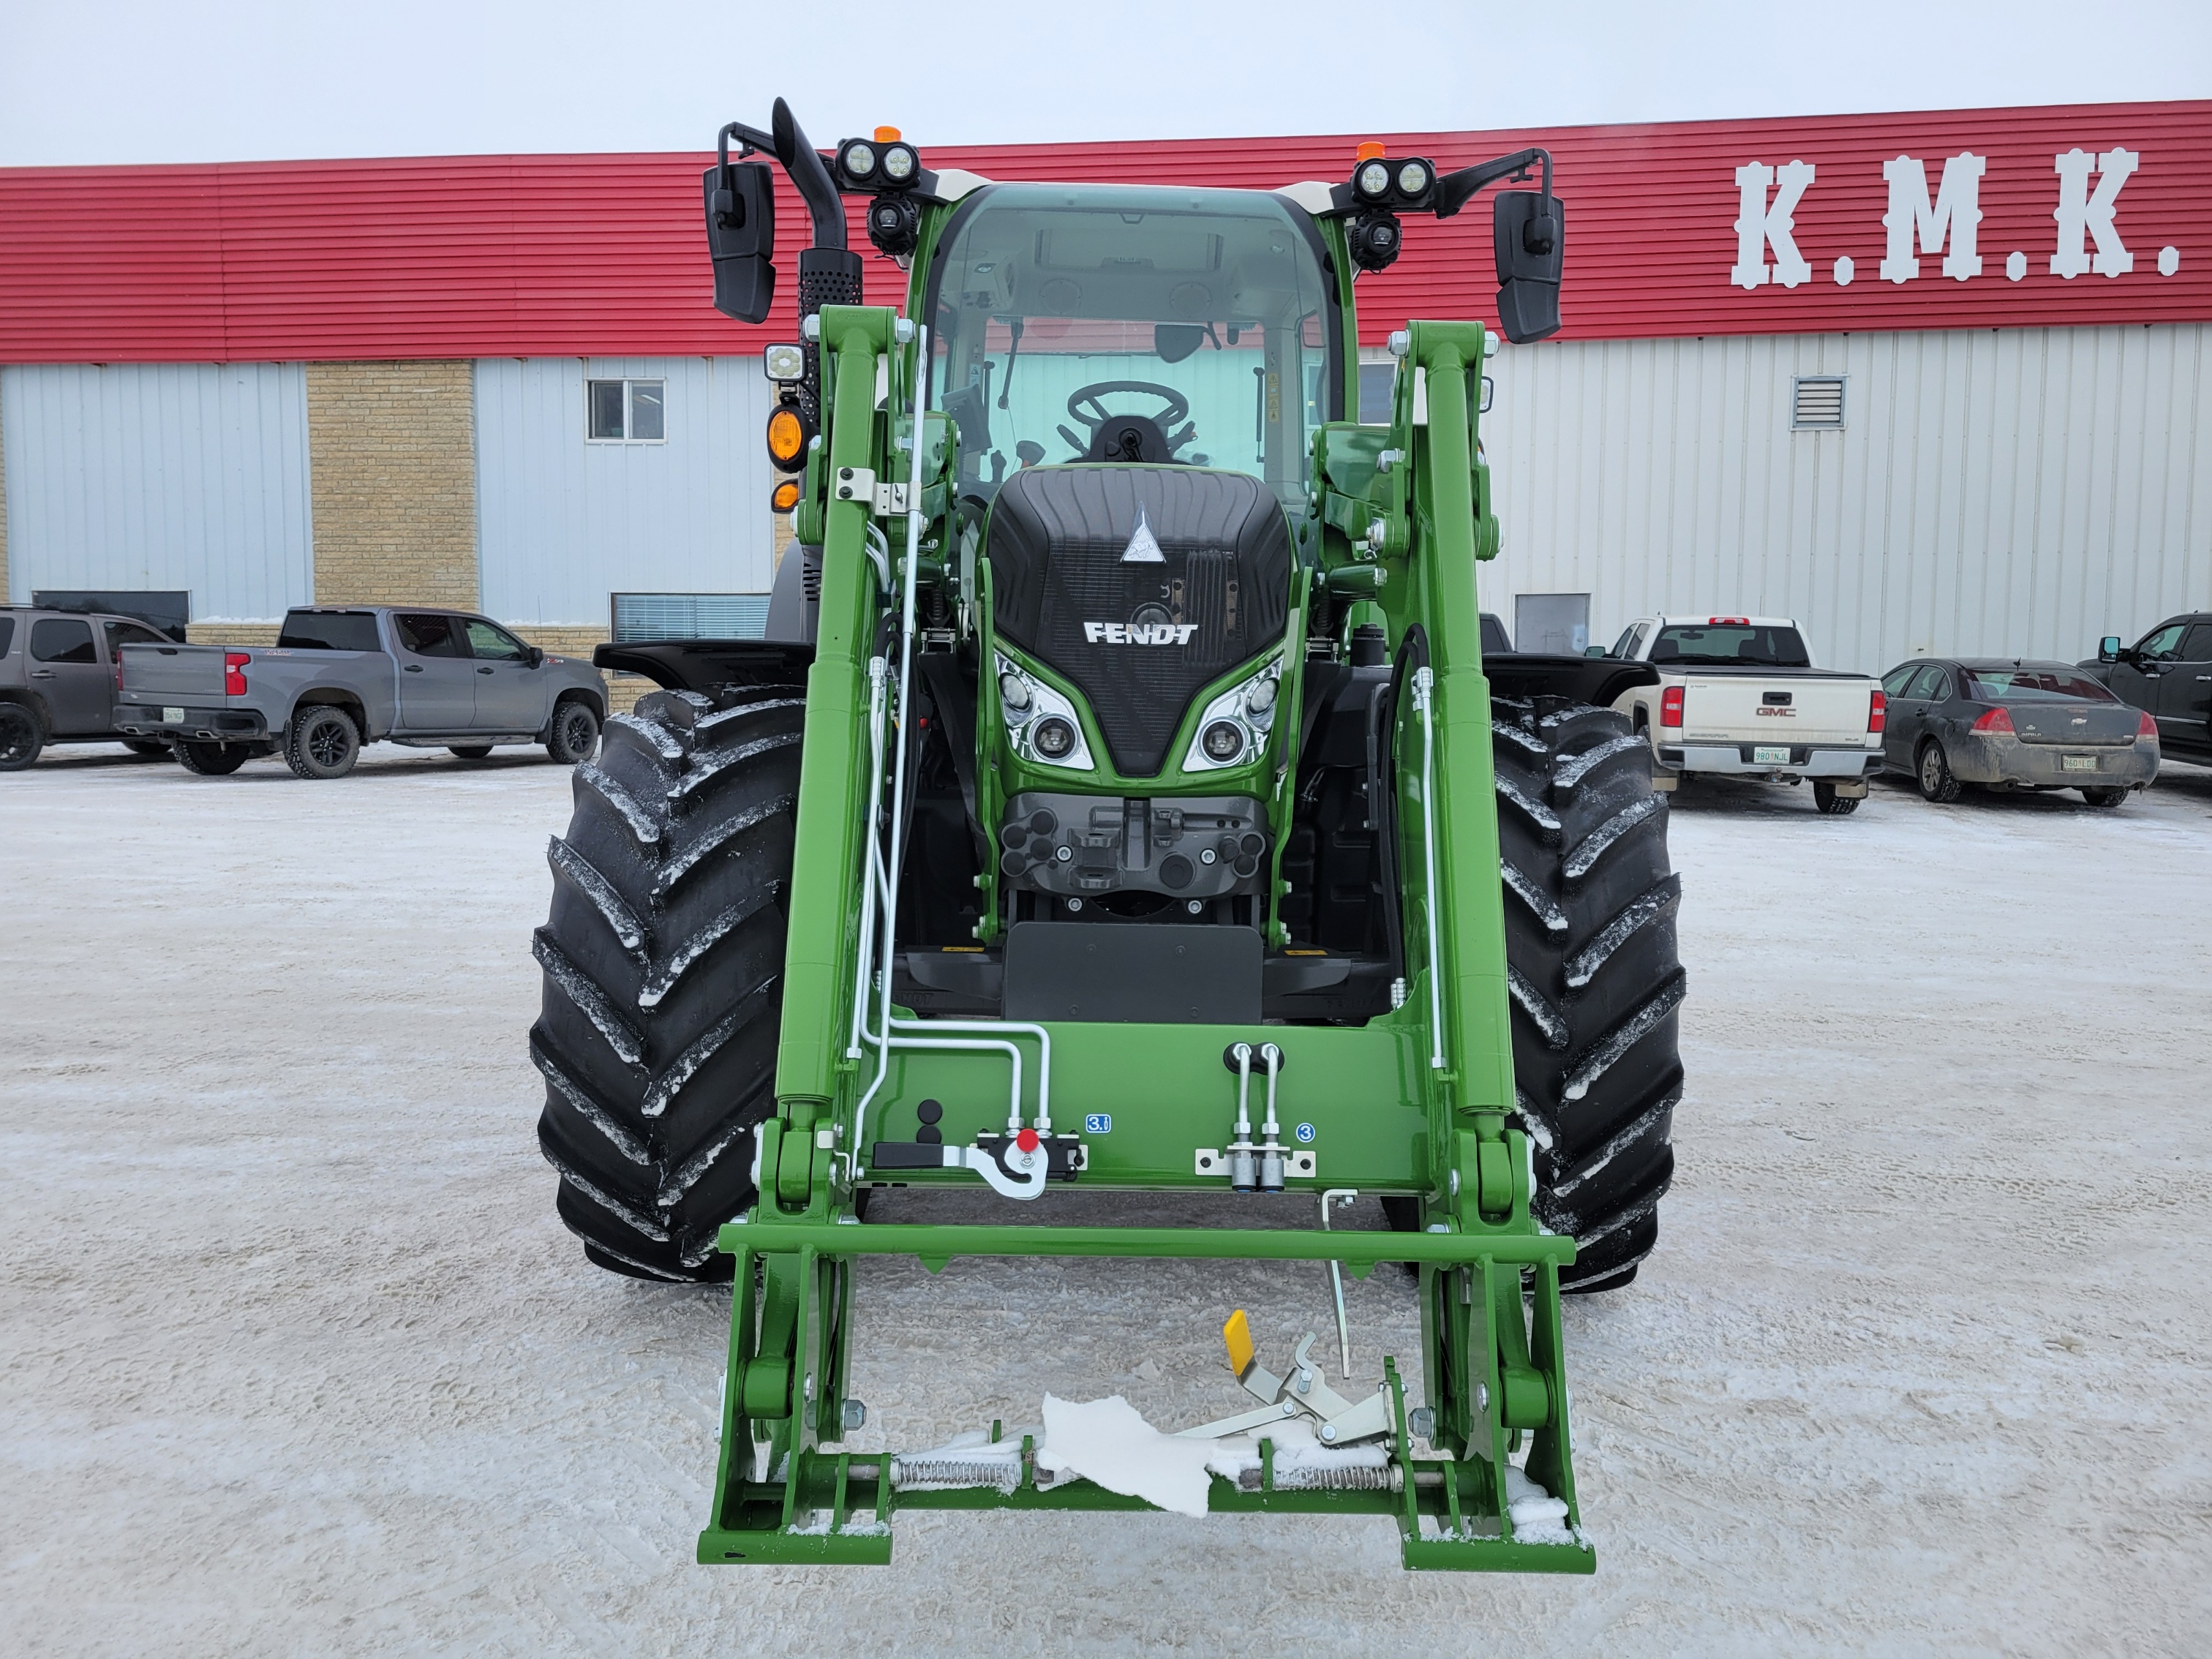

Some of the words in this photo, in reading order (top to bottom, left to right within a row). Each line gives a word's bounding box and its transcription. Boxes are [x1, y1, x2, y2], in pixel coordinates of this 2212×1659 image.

[1731, 147, 2179, 290] K.M.K.
[1083, 622, 1199, 645] FENDT
[1756, 707, 1797, 717] GMC
[1756, 752, 1770, 761] 980
[1774, 752, 1788, 761] NJL
[2064, 759, 2077, 768] 960
[1300, 1125, 1312, 1140] 3
